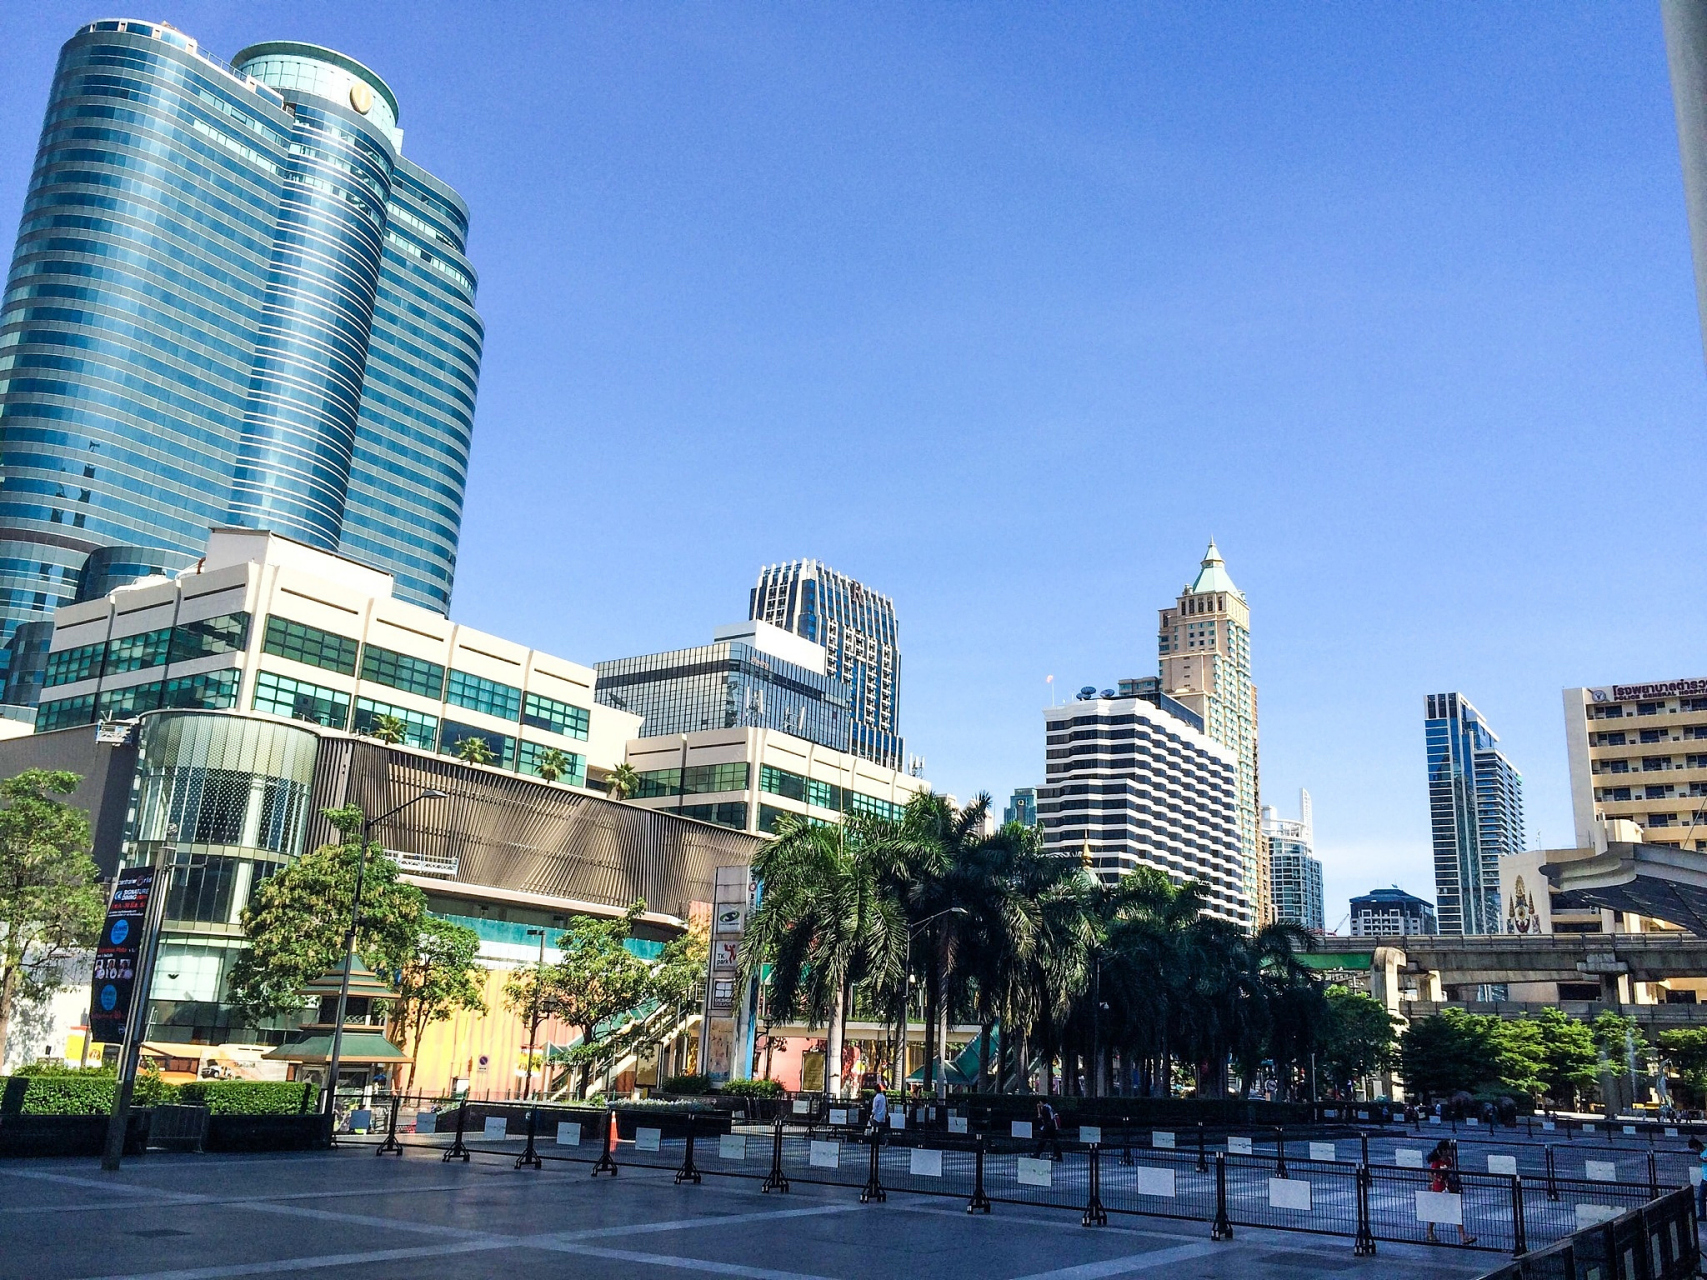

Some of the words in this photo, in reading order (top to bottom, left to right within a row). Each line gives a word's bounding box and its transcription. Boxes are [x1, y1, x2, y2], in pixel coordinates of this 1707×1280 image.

[1612, 679, 1707, 696] โรงพยาบาลตำรว
[1679, 688, 1707, 696] HOSPIT
